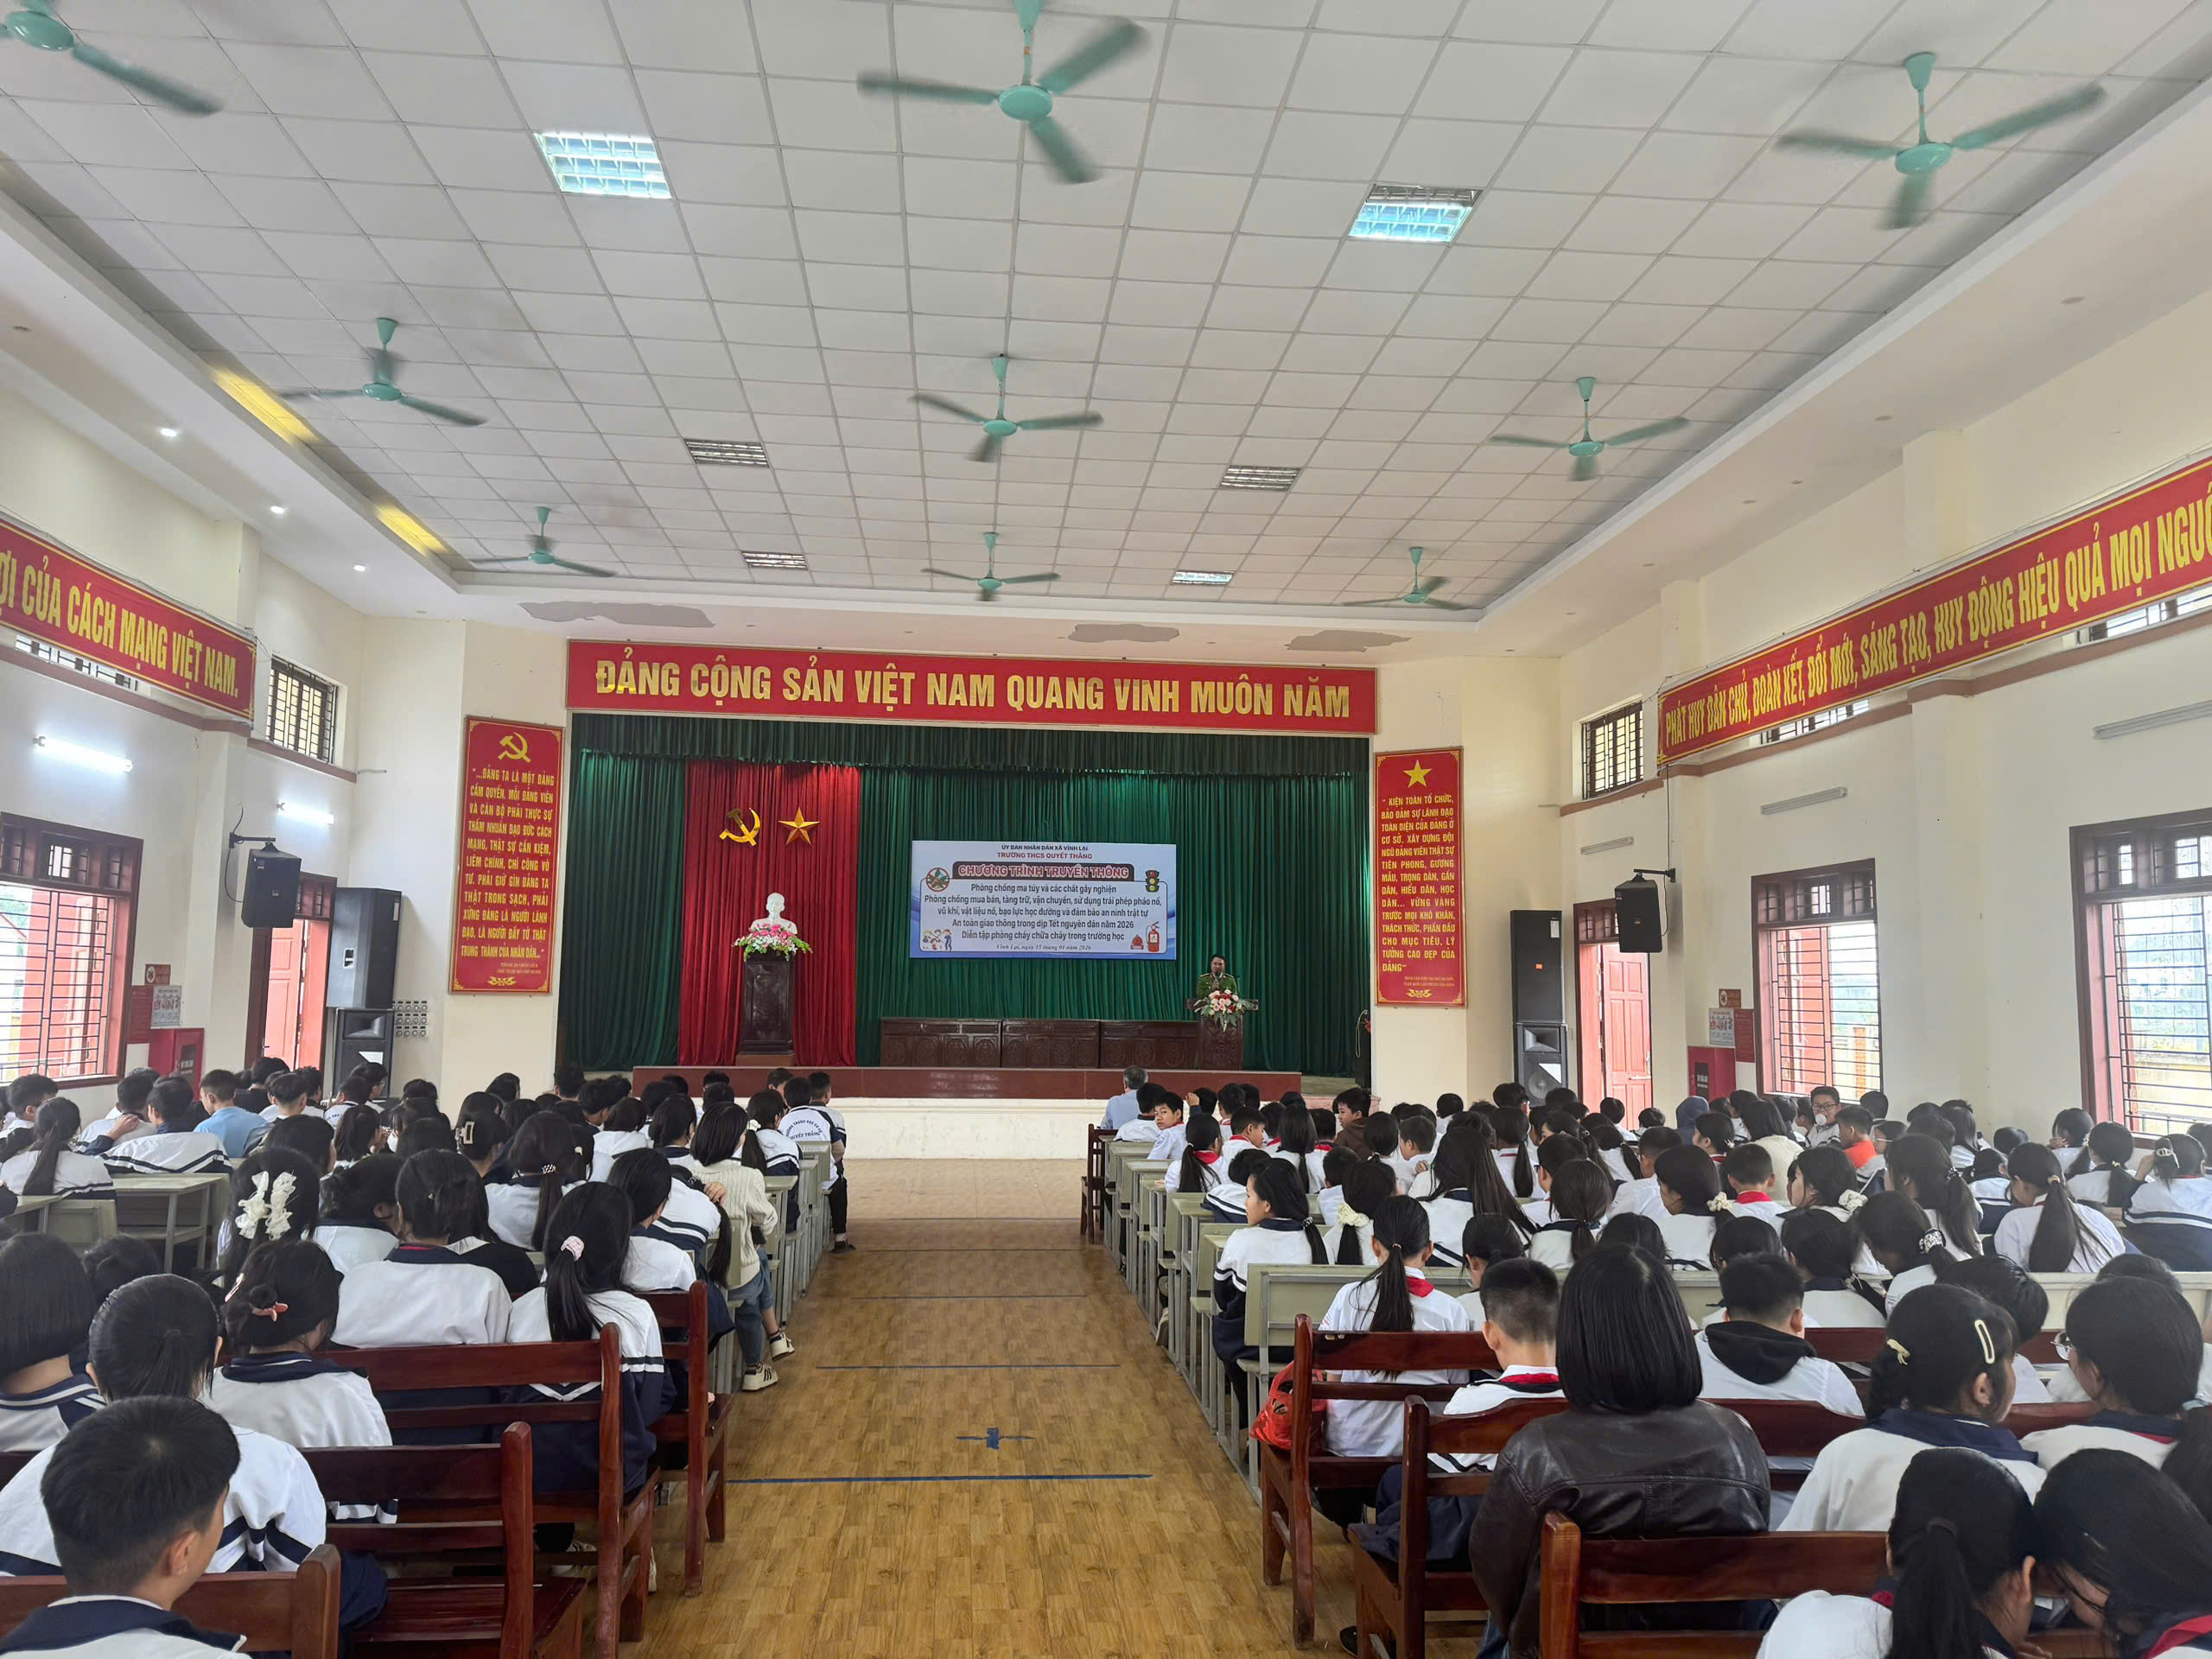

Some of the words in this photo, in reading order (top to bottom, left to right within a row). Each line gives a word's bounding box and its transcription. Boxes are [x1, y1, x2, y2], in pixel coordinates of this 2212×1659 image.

[22, 555, 61, 628] CỦA
[67, 582, 117, 650] CÁCH
[119, 607, 168, 671] MẠNG
[172, 630, 203, 689] VIỆT
[204, 646, 238, 698] NAM.
[1666, 700, 1687, 747] PHÁT
[1688, 698, 1706, 740] HUY
[1707, 684, 1726, 734] DÂN
[1728, 669, 1751, 725] CHỦ,
[1752, 664, 1782, 717] ĐOÀN
[1783, 648, 1806, 706] KẾT,
[1807, 634, 1827, 698] ĐỔI
[1829, 632, 1858, 690] MỚI,
[1860, 620, 1898, 680] SÁNG
[1899, 611, 1932, 673] TẠO,
[1934, 595, 1963, 654] HUY
[1967, 575, 2015, 648] ĐỘNG
[2018, 552, 2060, 629] HIỆU
[2065, 521, 2107, 612] QUẢ
[2109, 521, 2152, 597] MỌI
[596, 647, 680, 696] ĐẢNG
[691, 654, 772, 706] CỘNG
[782, 655, 843, 702] SẢN
[855, 663, 915, 711] VIỆT
[927, 672, 995, 707] NAM
[1007, 675, 1103, 712] QUANG
[1113, 677, 1179, 713] VINH
[1191, 673, 1273, 715] MUÔN
[1283, 676, 1350, 718] NĂM
[958, 864, 1008, 877] CHƯƠNG
[1008, 863, 1044, 878] TRÌNH
[1045, 864, 1089, 878] TRUYỀN
[1090, 865, 1129, 879] THÔNG
[971, 883, 994, 893] Phòng
[994, 882, 1015, 893] chống
[1063, 884, 1078, 893] chất
[1093, 885, 1116, 894] nghiện
[925, 894, 947, 904] Phòng
[947, 894, 969, 905] chống
[1002, 895, 1018, 905] tàng
[1084, 897, 1102, 906] dụng
[973, 907, 986, 916] liệu
[998, 907, 1012, 916] bạo
[1025, 907, 1037, 917] học
[1039, 907, 1060, 917] đường
[963, 918, 978, 927] toàn
[980, 919, 995, 928] giao
[995, 918, 1015, 928] thông
[1036, 919, 1047, 929] dịp
[1049, 919, 1058, 928] Tết
[1060, 920, 1086, 929] nguyên
[978, 931, 989, 940] tập
[991, 931, 1013, 940] phòng
[1014, 931, 1030, 940] cháy
[1032, 931, 1049, 939] chữa
[1050, 931, 1066, 940] cháy
[1068, 932, 1086, 941] trong
[1088, 931, 1110, 941] trường
[1112, 932, 1124, 942] học
[1382, 937, 1397, 945] CHO
[1407, 950, 1421, 959] CAO
